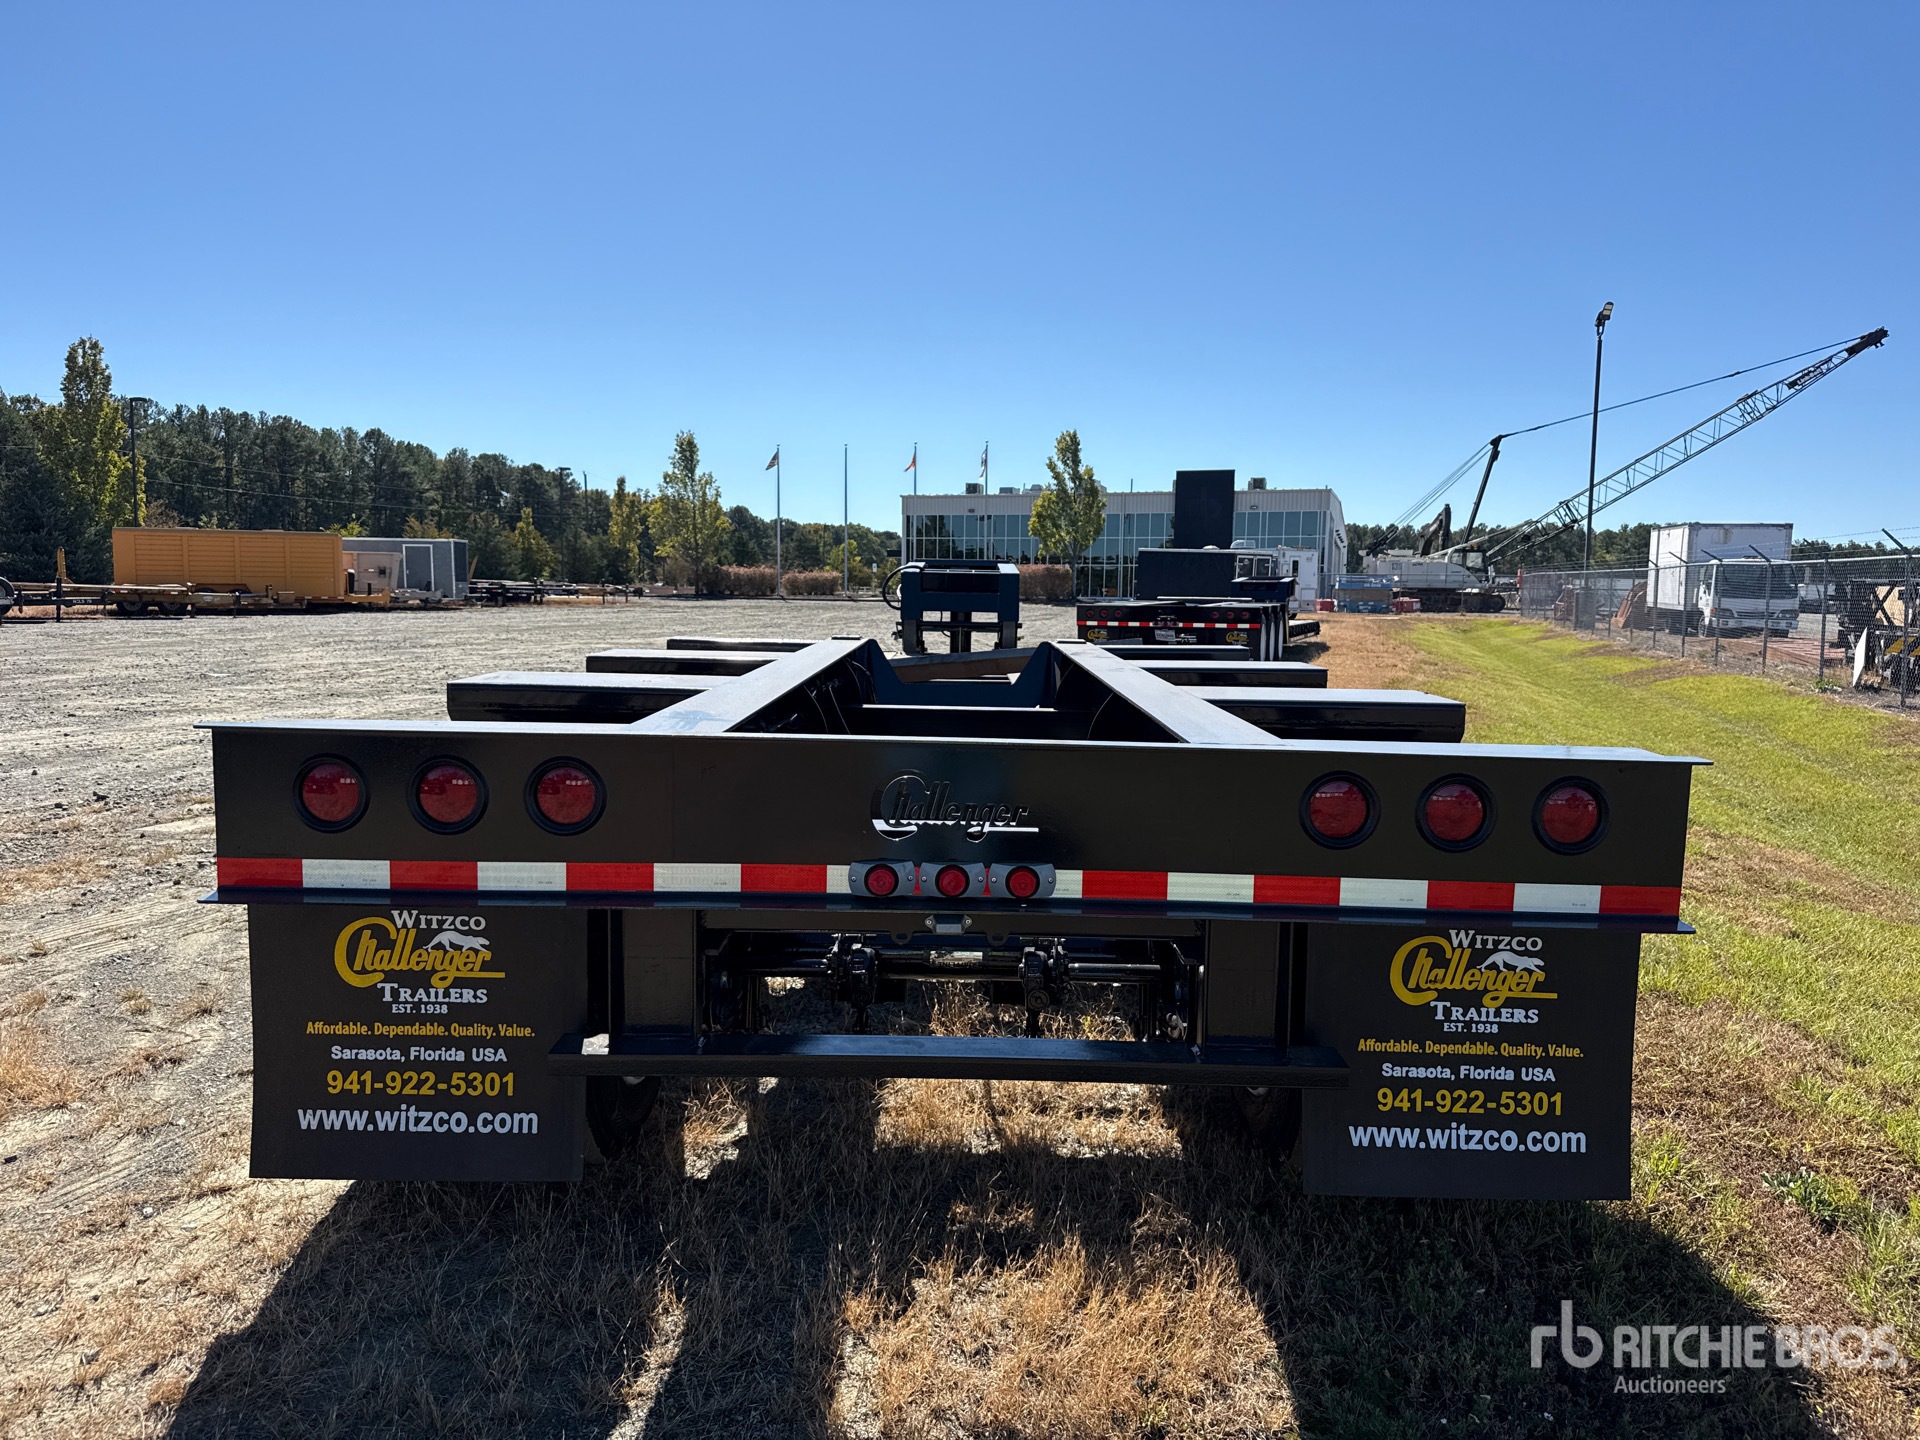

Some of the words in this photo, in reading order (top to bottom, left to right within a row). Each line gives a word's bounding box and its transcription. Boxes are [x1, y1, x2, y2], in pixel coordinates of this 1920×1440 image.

[870, 769, 1040, 843] Challenger
[334, 917, 505, 988] Challenger
[1390, 935, 1558, 1008] Challenger
[377, 982, 488, 1003] TRAILERS
[392, 1004, 416, 1014] EST.
[420, 1004, 449, 1014] 1938
[1430, 1001, 1539, 1023] TRAILERS
[306, 1021, 371, 1035] Affordable.
[374, 1022, 449, 1038] Dependable.
[451, 1023, 496, 1039] Quality.
[499, 1024, 535, 1037] Value.
[1443, 1022, 1467, 1033] EST.
[1471, 1023, 1499, 1033] 1938
[331, 1046, 405, 1062] Sarasota,
[410, 1047, 465, 1062] Florida
[472, 1048, 507, 1062] USA
[1358, 1038, 1422, 1053] Affordable.
[1426, 1040, 1498, 1056] Dependable.
[1501, 1043, 1546, 1059] Quality.
[1548, 1044, 1584, 1058] Value.
[327, 1070, 515, 1096] 941-922-5301
[1382, 1063, 1455, 1080] Sarasota,
[1460, 1066, 1514, 1081] Florida
[1521, 1067, 1556, 1082] USA
[1377, 1088, 1562, 1116] 941-922-5301
[298, 1104, 538, 1134] www.witzco.com
[1349, 1122, 1586, 1153] www.witzco.com
